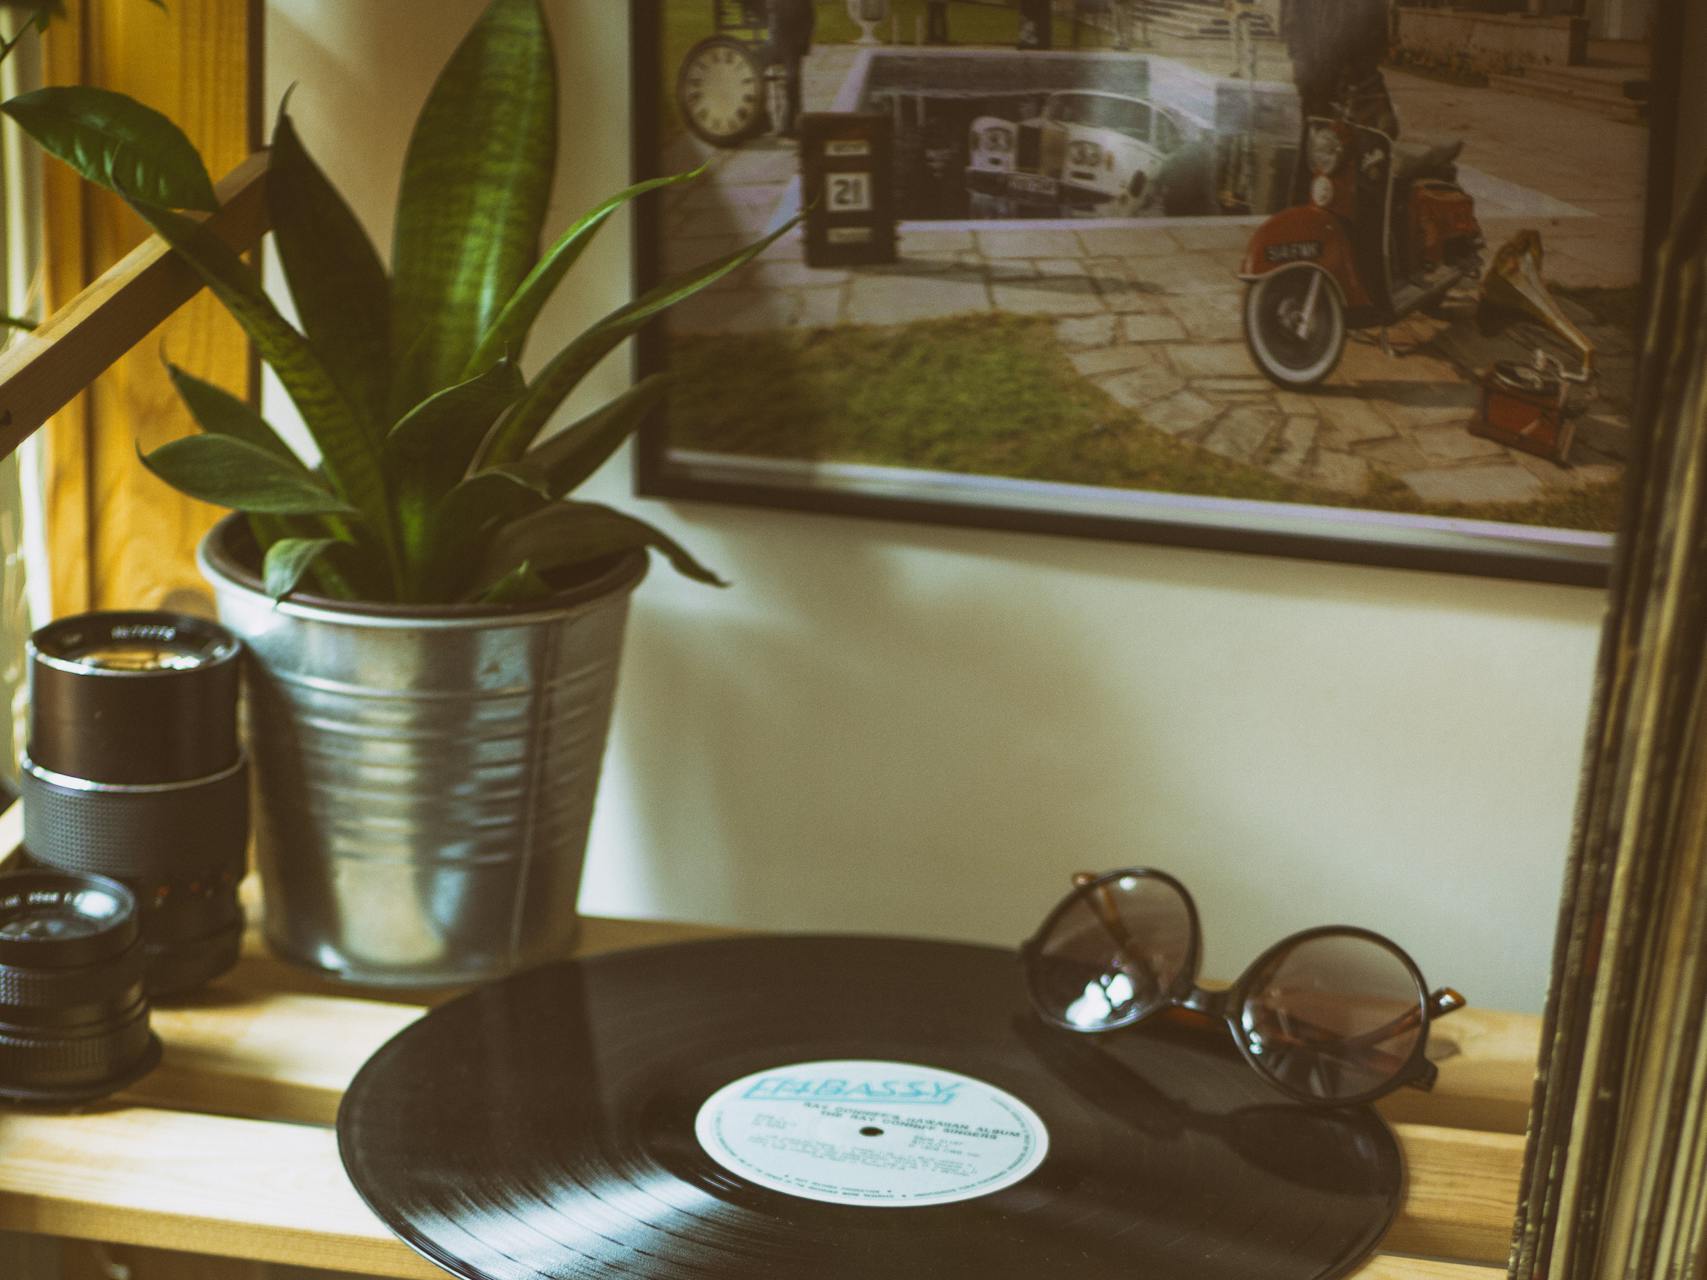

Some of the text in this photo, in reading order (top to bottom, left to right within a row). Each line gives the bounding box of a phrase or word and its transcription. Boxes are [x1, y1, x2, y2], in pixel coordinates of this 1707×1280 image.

[833, 178, 863, 205] 21
[742, 1077, 965, 1101] EMBASSY
[850, 1112, 876, 1123] RAY
[941, 1126, 999, 1141] SINGERS
[975, 1126, 1021, 1138] ALBUM
